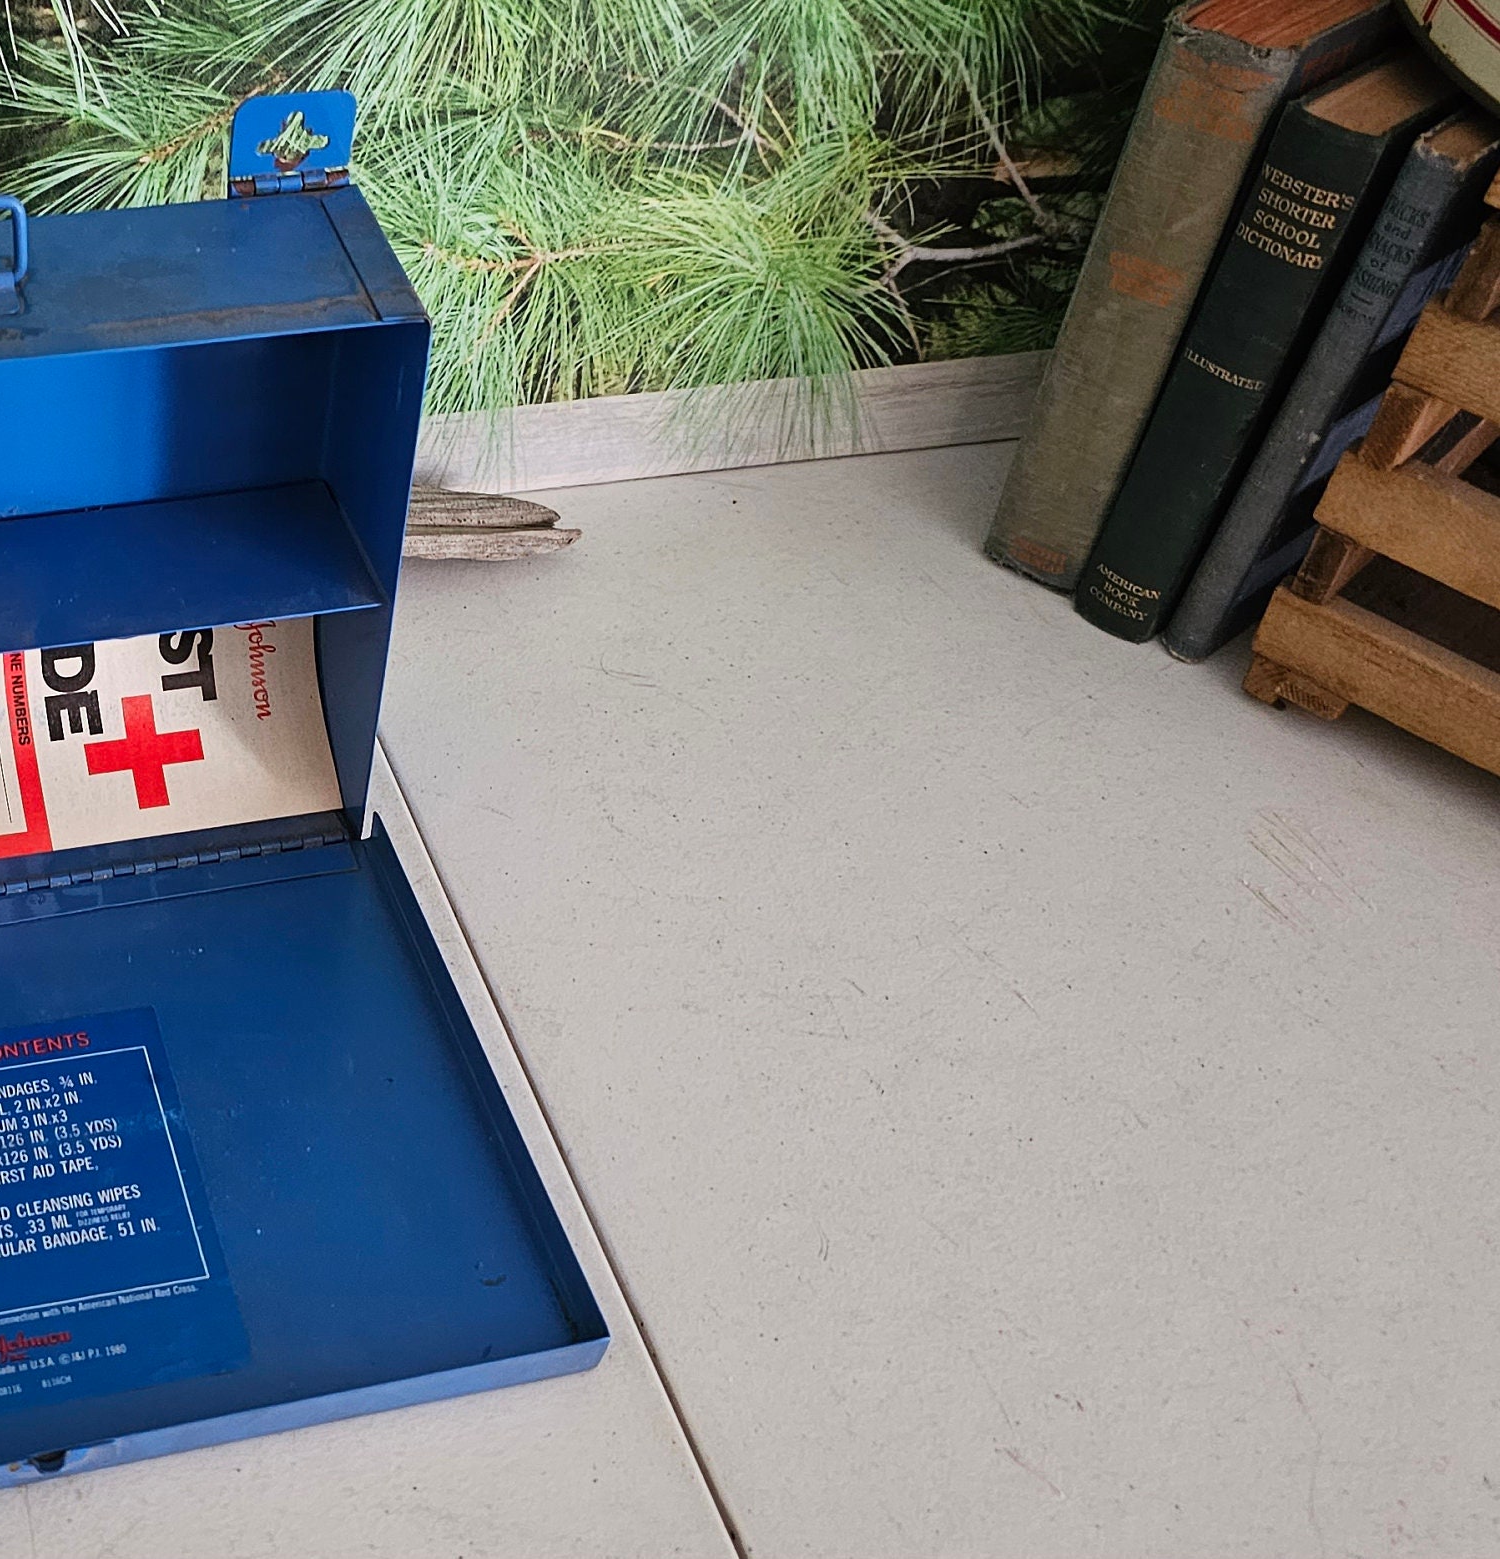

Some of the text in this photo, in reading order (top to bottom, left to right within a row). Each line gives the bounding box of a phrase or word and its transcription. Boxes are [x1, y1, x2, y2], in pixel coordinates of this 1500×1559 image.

[1262, 163, 1355, 211] WEBSTER'S
[1258, 187, 1336, 230] SHORTER
[1253, 208, 1321, 249] SCHOOL
[1184, 347, 1267, 391] ILLUSTRATED
[1097, 563, 1161, 600] AMERICAN
[1103, 582, 1140, 608] BOOK
[1090, 585, 1148, 621] COMPANY
[11, 675, 31, 746] NUMBERS
[78, 1072, 97, 1086] IN.
[14, 1100, 23, 1114] 2
[64, 1090, 83, 1105] IN.
[21, 1115, 30, 1129] 3
[29, 1129, 49, 1144] IN.
[54, 1124, 81, 1141] (3.5
[85, 1117, 118, 1135] YDS)
[34, 1146, 53, 1161] IN.
[58, 1140, 86, 1158] (3.5
[90, 1134, 123, 1152] YDS)
[32, 1163, 55, 1180] AID
[59, 1156, 99, 1175] TAPE,
[16, 1192, 93, 1218] CLEANSING
[97, 1184, 142, 1205] WIPES
[24, 1218, 46, 1235] .33
[51, 1214, 72, 1230] ML
[42, 1226, 113, 1250] BANDAGE,
[117, 1221, 136, 1237] 51
[140, 1217, 161, 1233] IN.
[42, 1307, 61, 1318] with
[62, 1304, 76, 1314] the
[78, 1298, 118, 1312] American
[118, 1291, 153, 1305] National
[155, 1286, 171, 1298] Red
[19, 1362, 28, 1372] in
